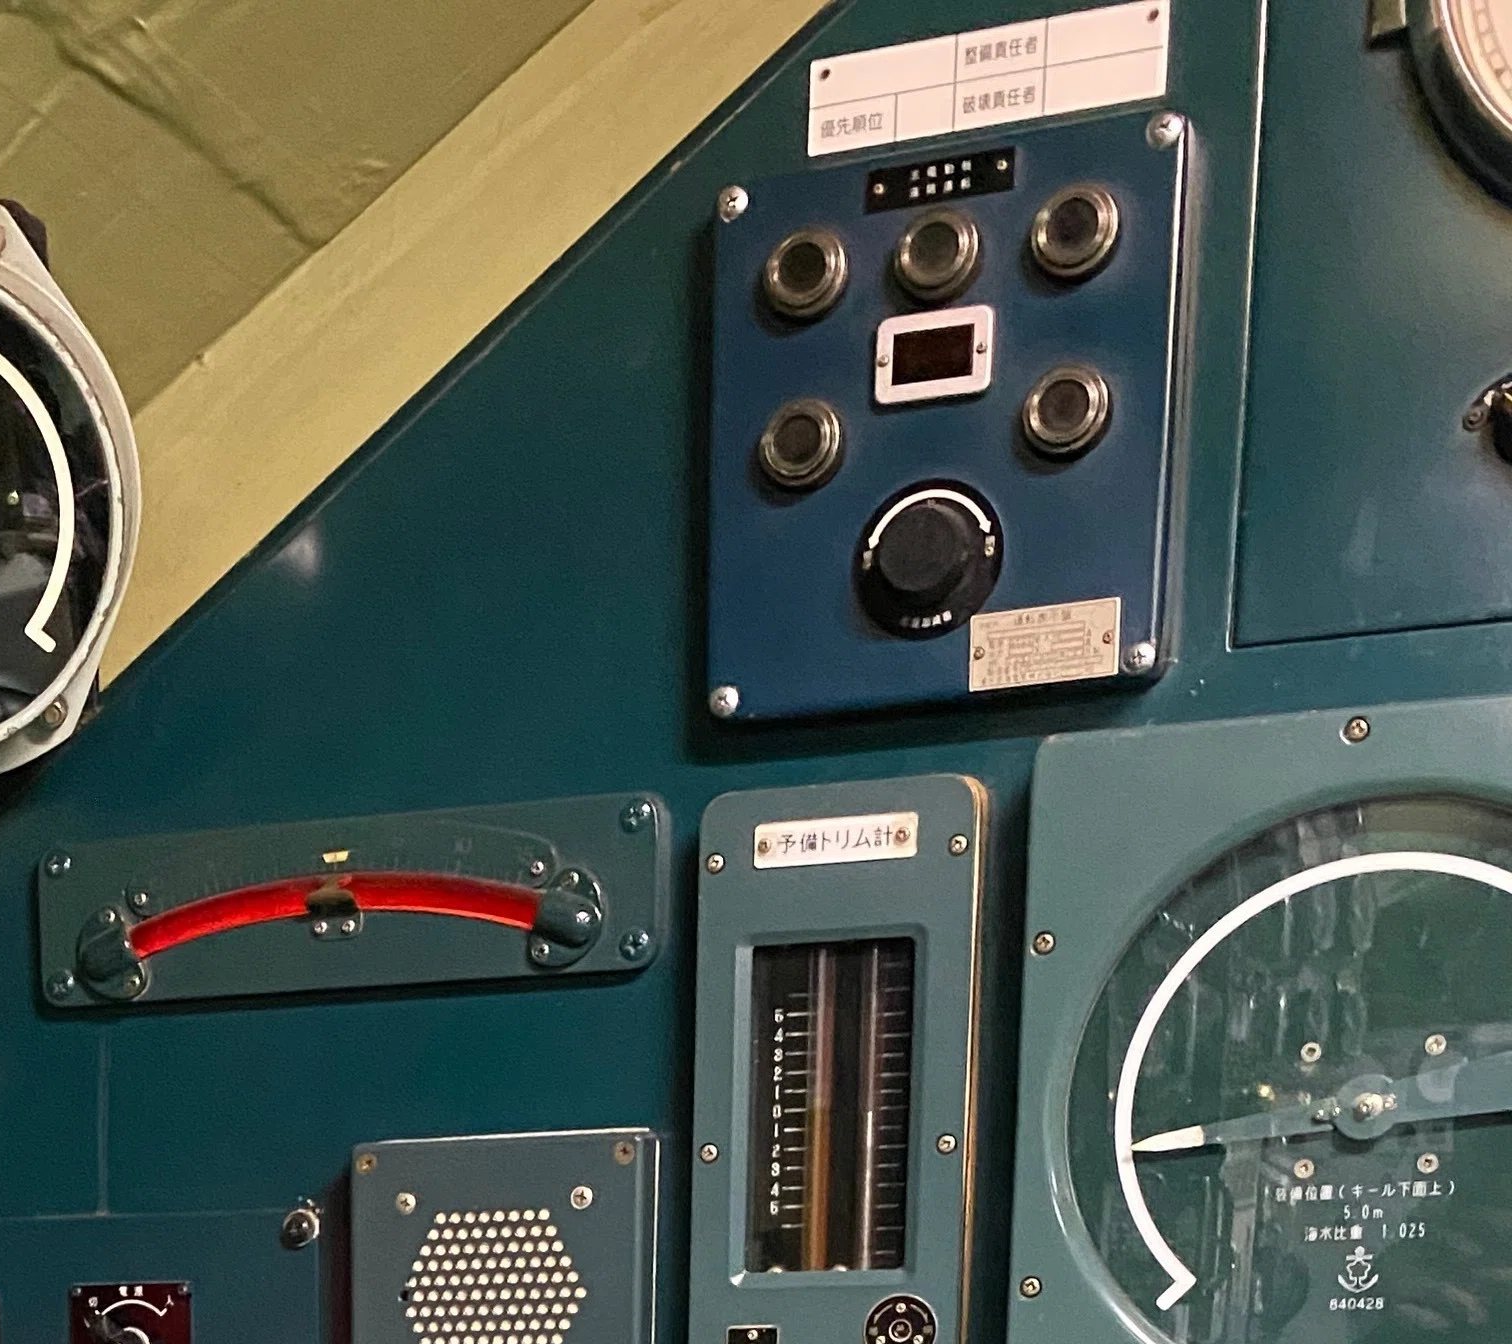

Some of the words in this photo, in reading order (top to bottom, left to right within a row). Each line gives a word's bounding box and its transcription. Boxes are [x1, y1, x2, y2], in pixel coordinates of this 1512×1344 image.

[964, 36, 1038, 65] 整備責任者
[962, 85, 1037, 114] 破壊責任者
[820, 112, 883, 139] 優先順位
[777, 825, 893, 854] 予備トリム計
[774, 1027, 784, 1043] 4
[773, 1048, 783, 1062] 3
[773, 1066, 783, 1080] 2
[775, 1084, 780, 1100] 1
[772, 1105, 782, 1119] 0
[774, 1123, 779, 1138] 1
[772, 1144, 781, 1158] 2
[771, 1162, 781, 1177] 3
[770, 1182, 780, 1197] 4
[1276, 1180, 1456, 1201] 装備位置（キール下面上）
[1343, 1204, 1384, 1220] 5.0m
[1304, 1224, 1363, 1241] 海水比重
[1381, 1222, 1426, 1239] 1.025
[1329, 1298, 1384, 1310] 840428
